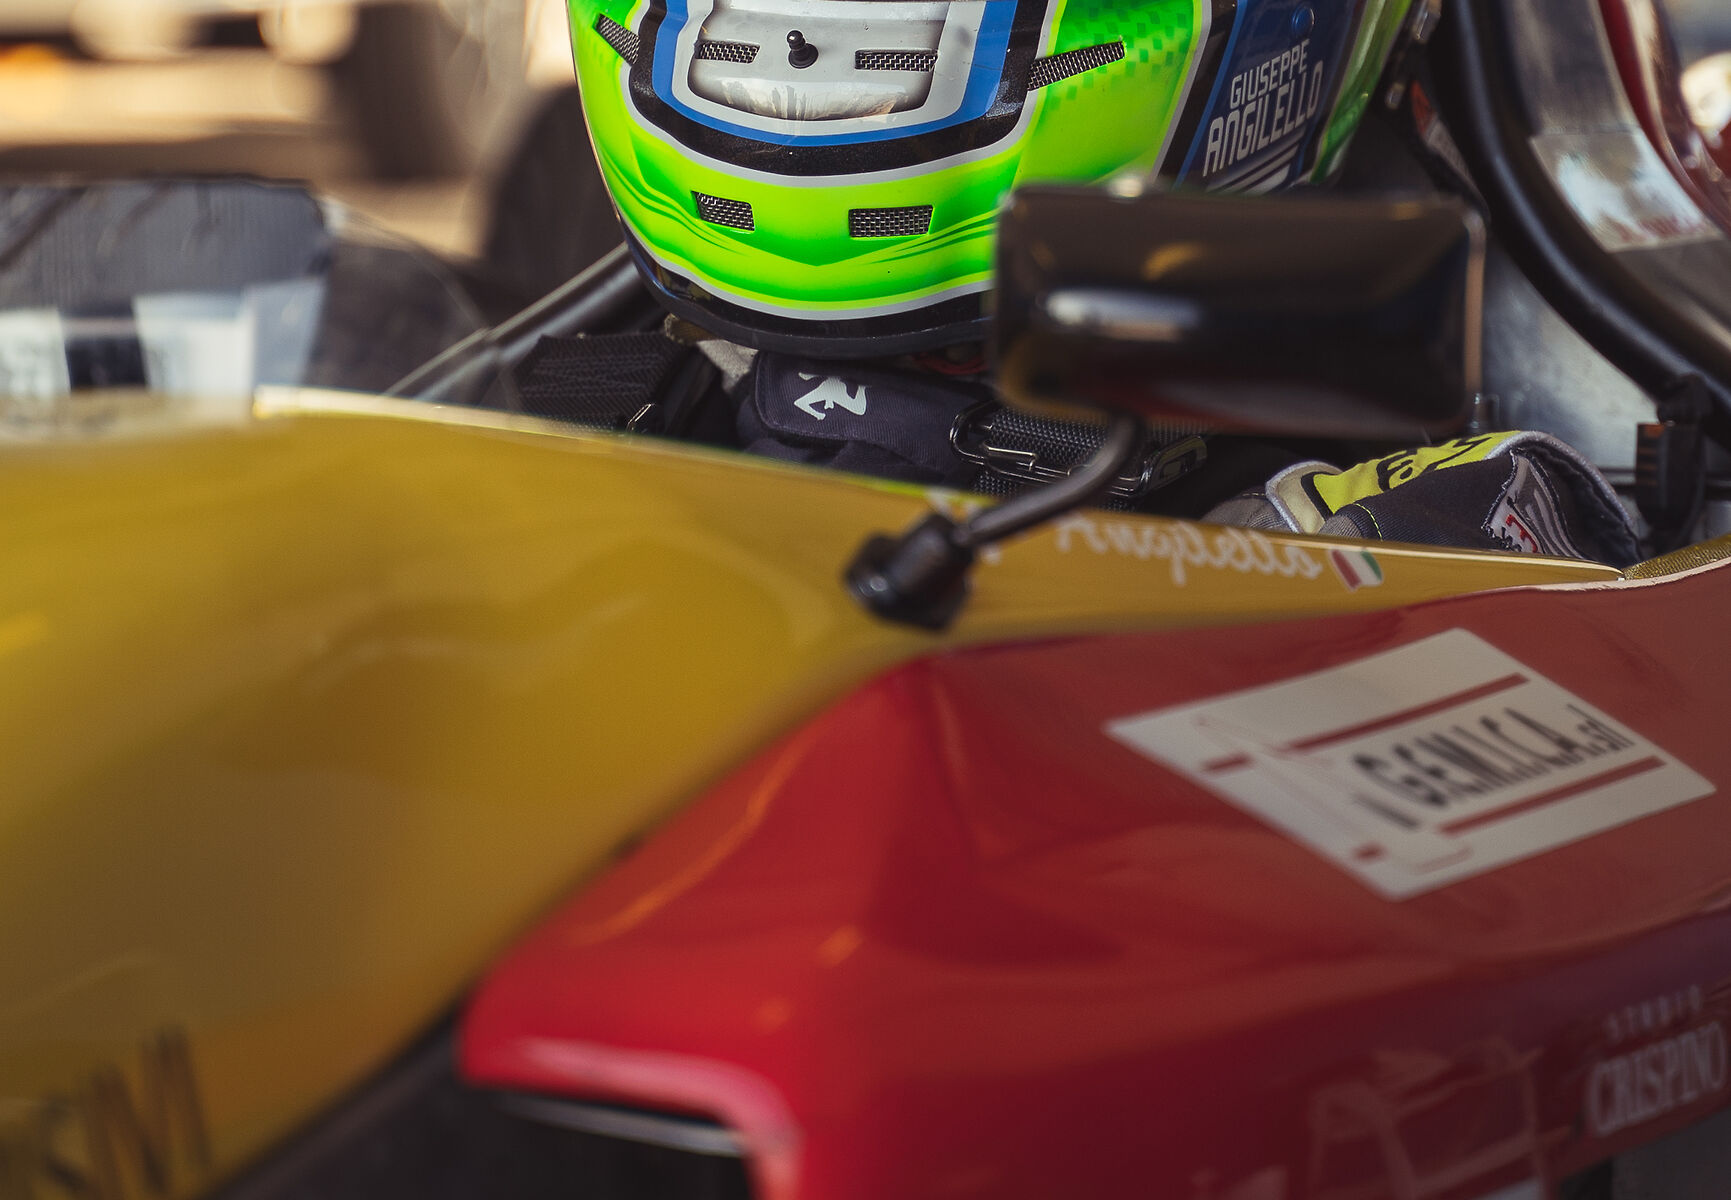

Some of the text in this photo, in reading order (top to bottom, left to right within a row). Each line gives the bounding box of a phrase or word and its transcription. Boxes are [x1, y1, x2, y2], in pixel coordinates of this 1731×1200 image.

[1202, 60, 1324, 177] ANGILELLO
[1229, 38, 1311, 110] GIUSEPPE
[1586, 1019, 1728, 1136] CRISPINO
